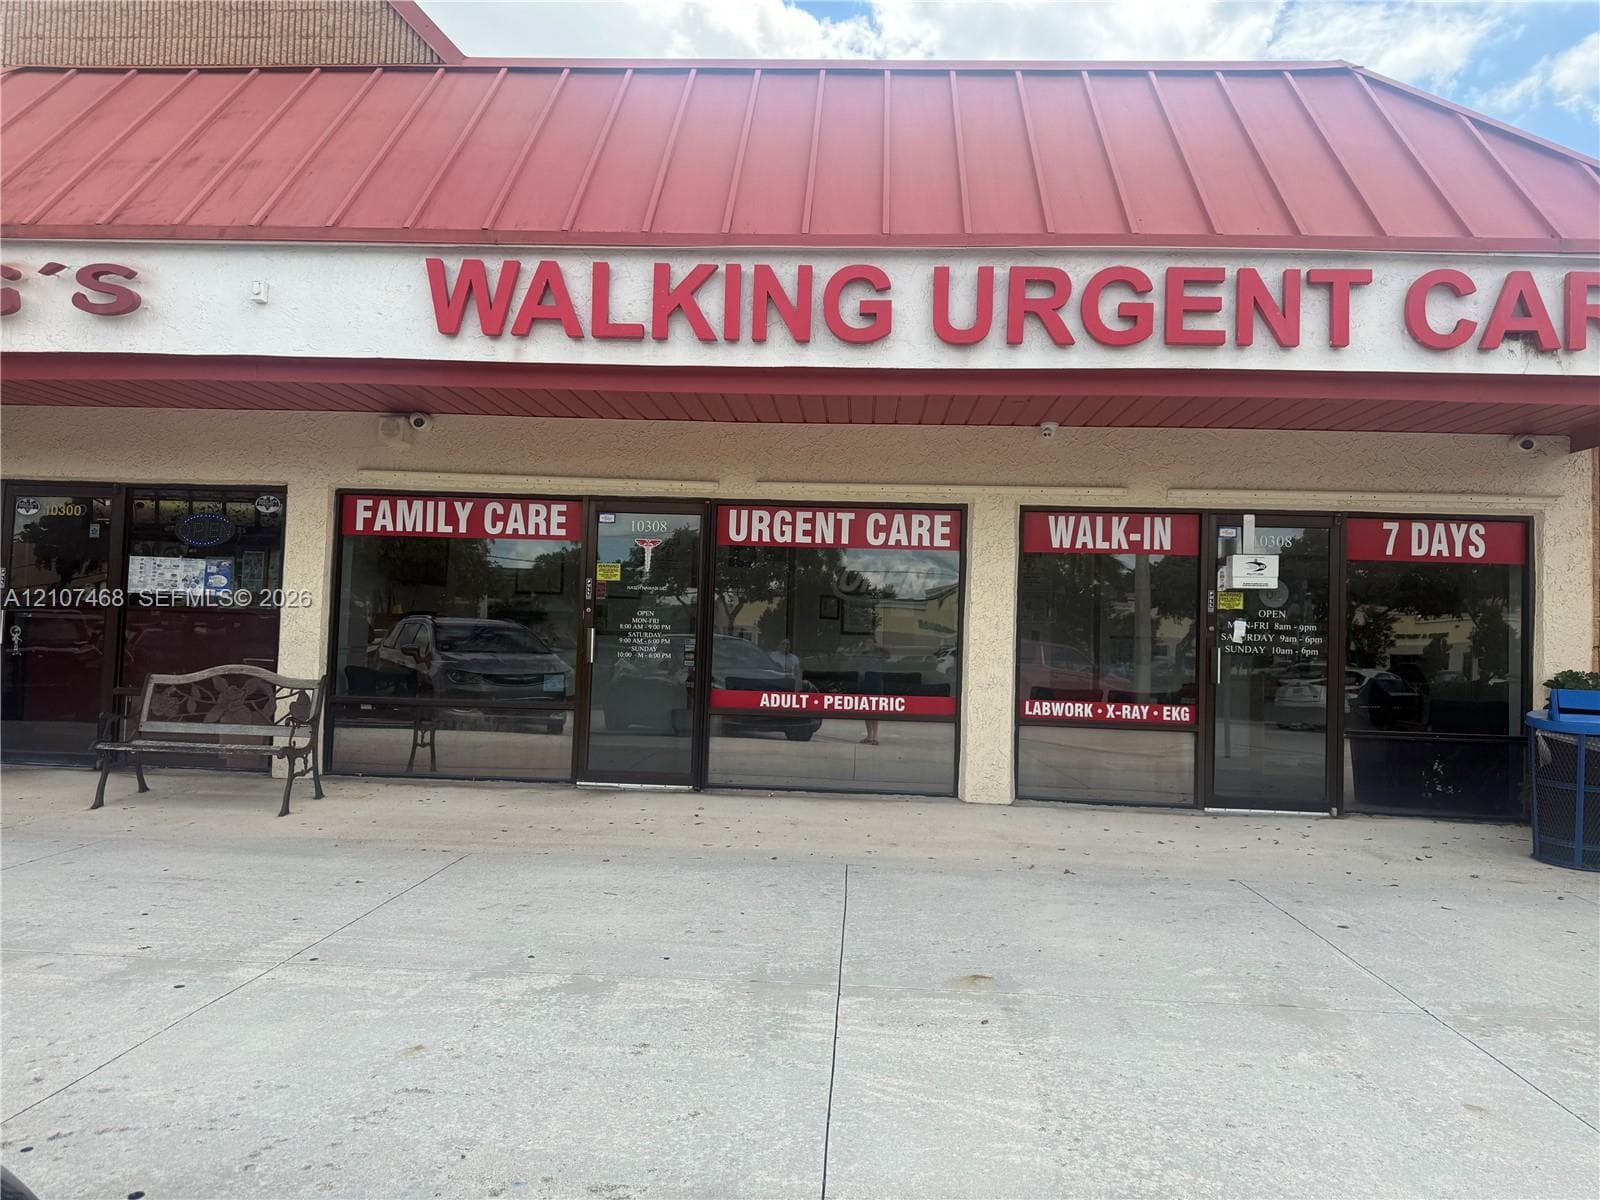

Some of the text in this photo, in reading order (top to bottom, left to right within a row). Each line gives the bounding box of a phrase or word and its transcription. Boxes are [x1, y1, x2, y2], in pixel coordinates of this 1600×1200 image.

[426, 257, 893, 345] WALKING
[933, 264, 1372, 347] URGENT
[355, 499, 568, 536] FAMILY CARE
[631, 520, 667, 532] 10308
[728, 508, 952, 549] URGENT CARE
[1048, 515, 1172, 551] WALK-IN
[1383, 522, 1486, 558] 7 DAYS
[1258, 609, 1287, 619] OPEN
[1227, 620, 1269, 630] MN-FRI
[1273, 623, 1292, 631] 8am
[1298, 624, 1317, 633] 9pm
[1221, 632, 1275, 642] SARDAY
[1279, 634, 1297, 643] 9am
[1304, 636, 1323, 645] 6pm
[1224, 644, 1266, 654] SUNDAY
[1271, 646, 1293, 655] 10am
[1301, 647, 1319, 657] 6pm
[759, 693, 906, 713] ADULT PEDIATRIC
[1025, 700, 1190, 721] LABWORK X-RAY EKG
